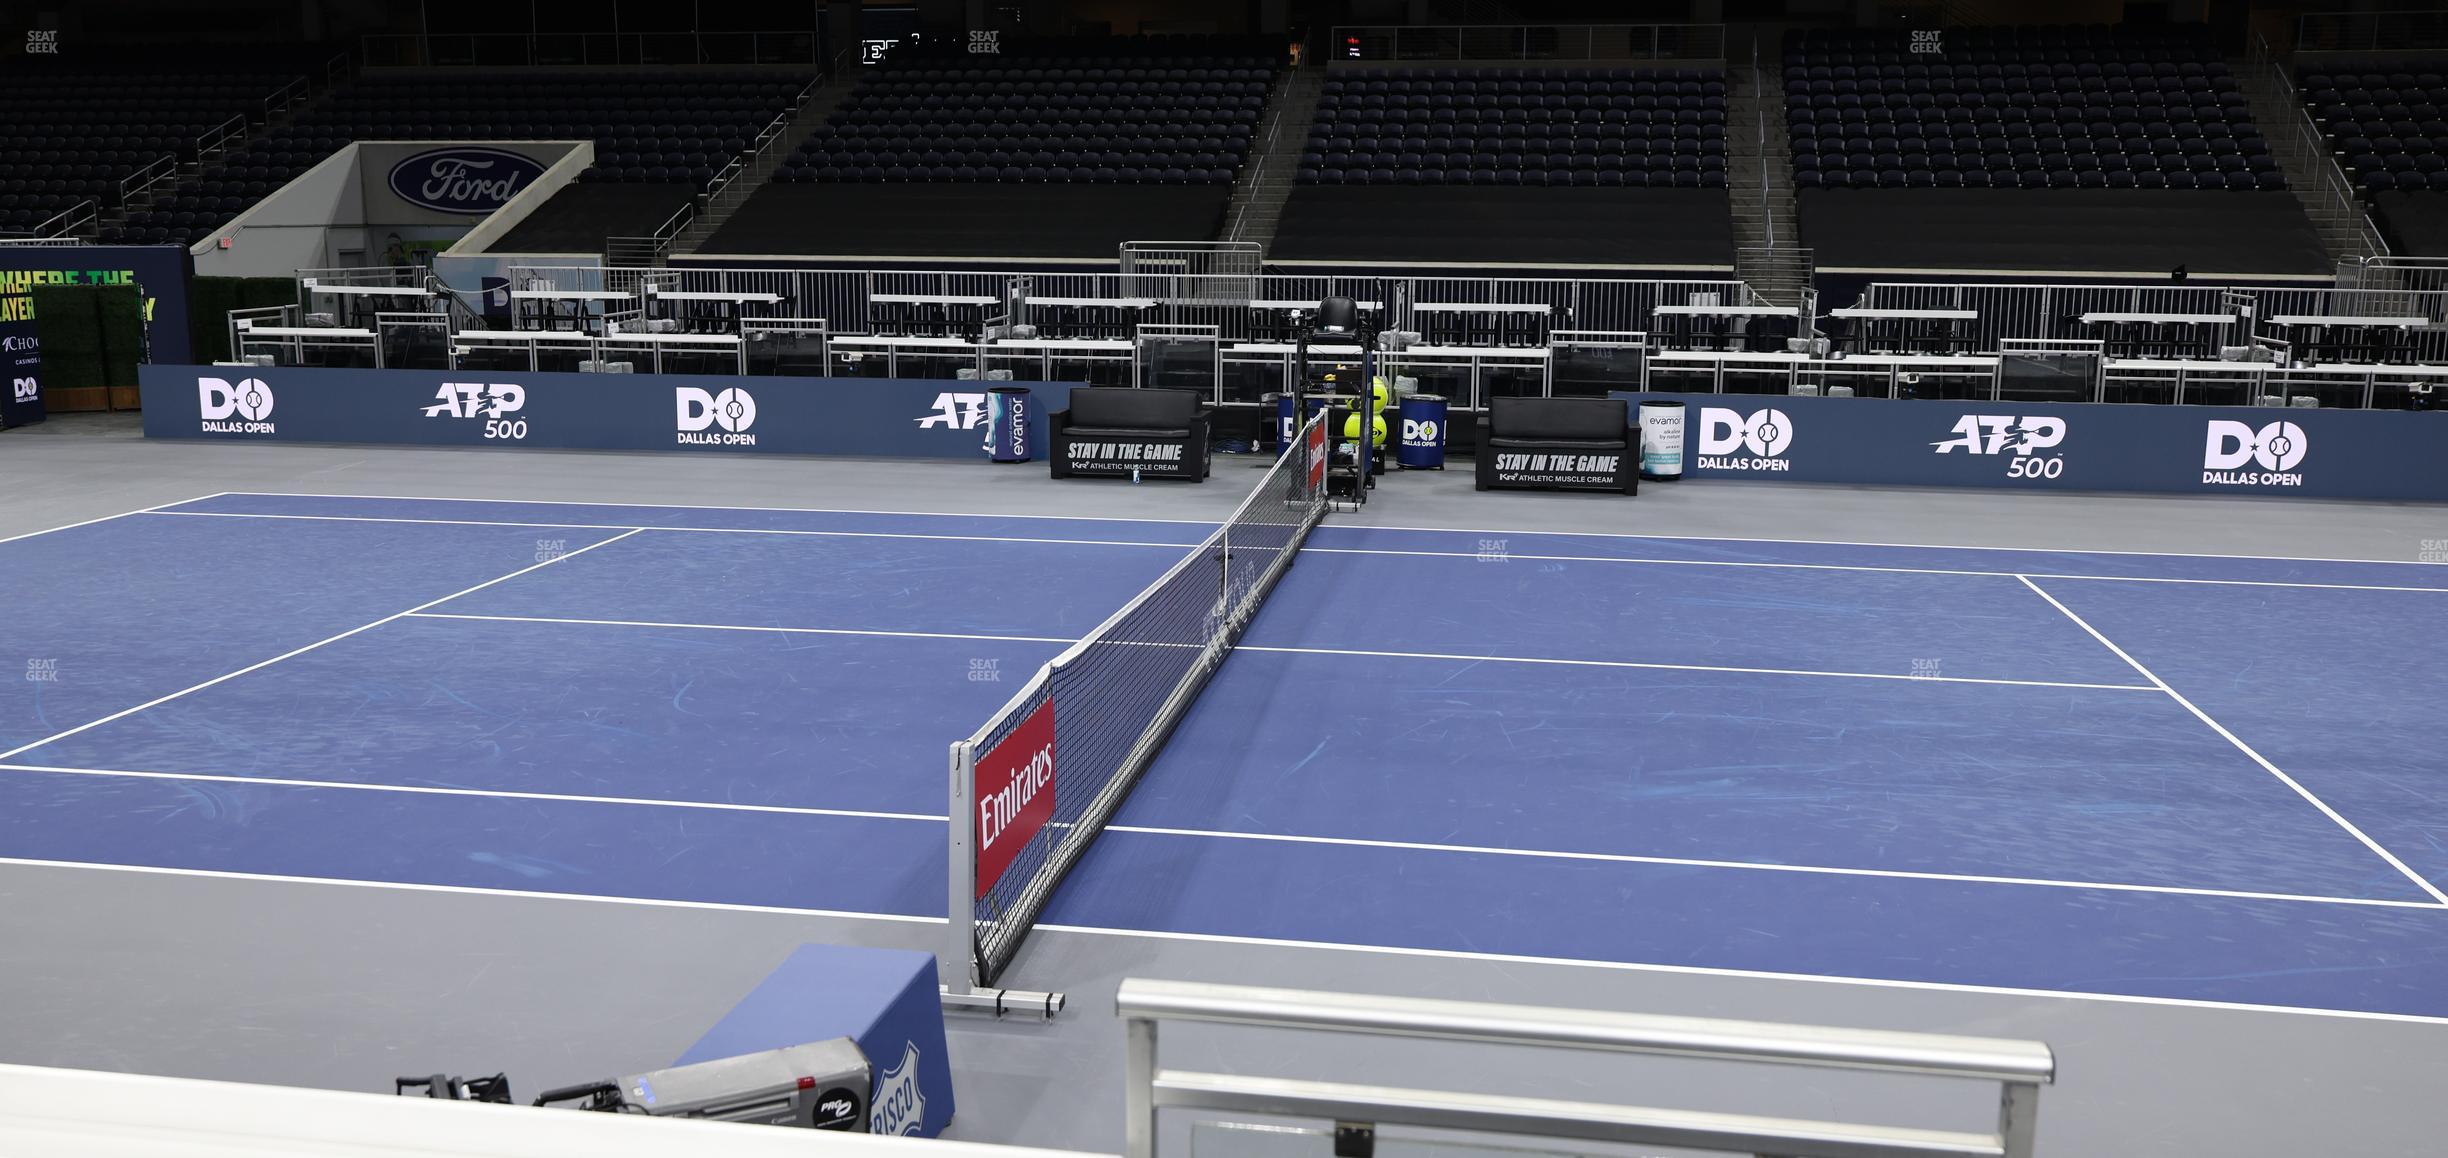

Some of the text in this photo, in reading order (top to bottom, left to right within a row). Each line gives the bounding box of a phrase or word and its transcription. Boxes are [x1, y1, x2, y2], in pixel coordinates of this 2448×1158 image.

[422, 158, 519, 200] Ford
[0, 297, 36, 321] AYER
[198, 377, 274, 421] DO
[420, 382, 526, 419] ATP
[675, 386, 757, 433] DO
[913, 392, 988, 430] AT
[202, 421, 275, 434] DALLAS OPEN
[484, 419, 527, 440] 500
[1013, 397, 1024, 456] evamor
[1402, 418, 1438, 442] DO
[1698, 407, 1793, 457] DO
[1929, 414, 2067, 456] ATP
[677, 432, 756, 446] DALLAS OPEN
[1402, 439, 1437, 448] DALLAS OPEN
[2203, 420, 2308, 472] DO
[1067, 442, 1183, 461] STAY IN THE GAME
[1495, 453, 1619, 473] STAY IN THE GAME
[1090, 462, 1123, 470] ATHLETIC
[1124, 463, 1153, 471] MUSCLE
[1697, 457, 1790, 472] DALLAS OPEN
[2006, 456, 2063, 479] 500
[1554, 475, 1586, 483] MUSCLE
[2202, 472, 2302, 486] DALLAS OPEN
[980, 742, 1053, 852] Emirates
[870, 1076, 913, 1136] RISCO
